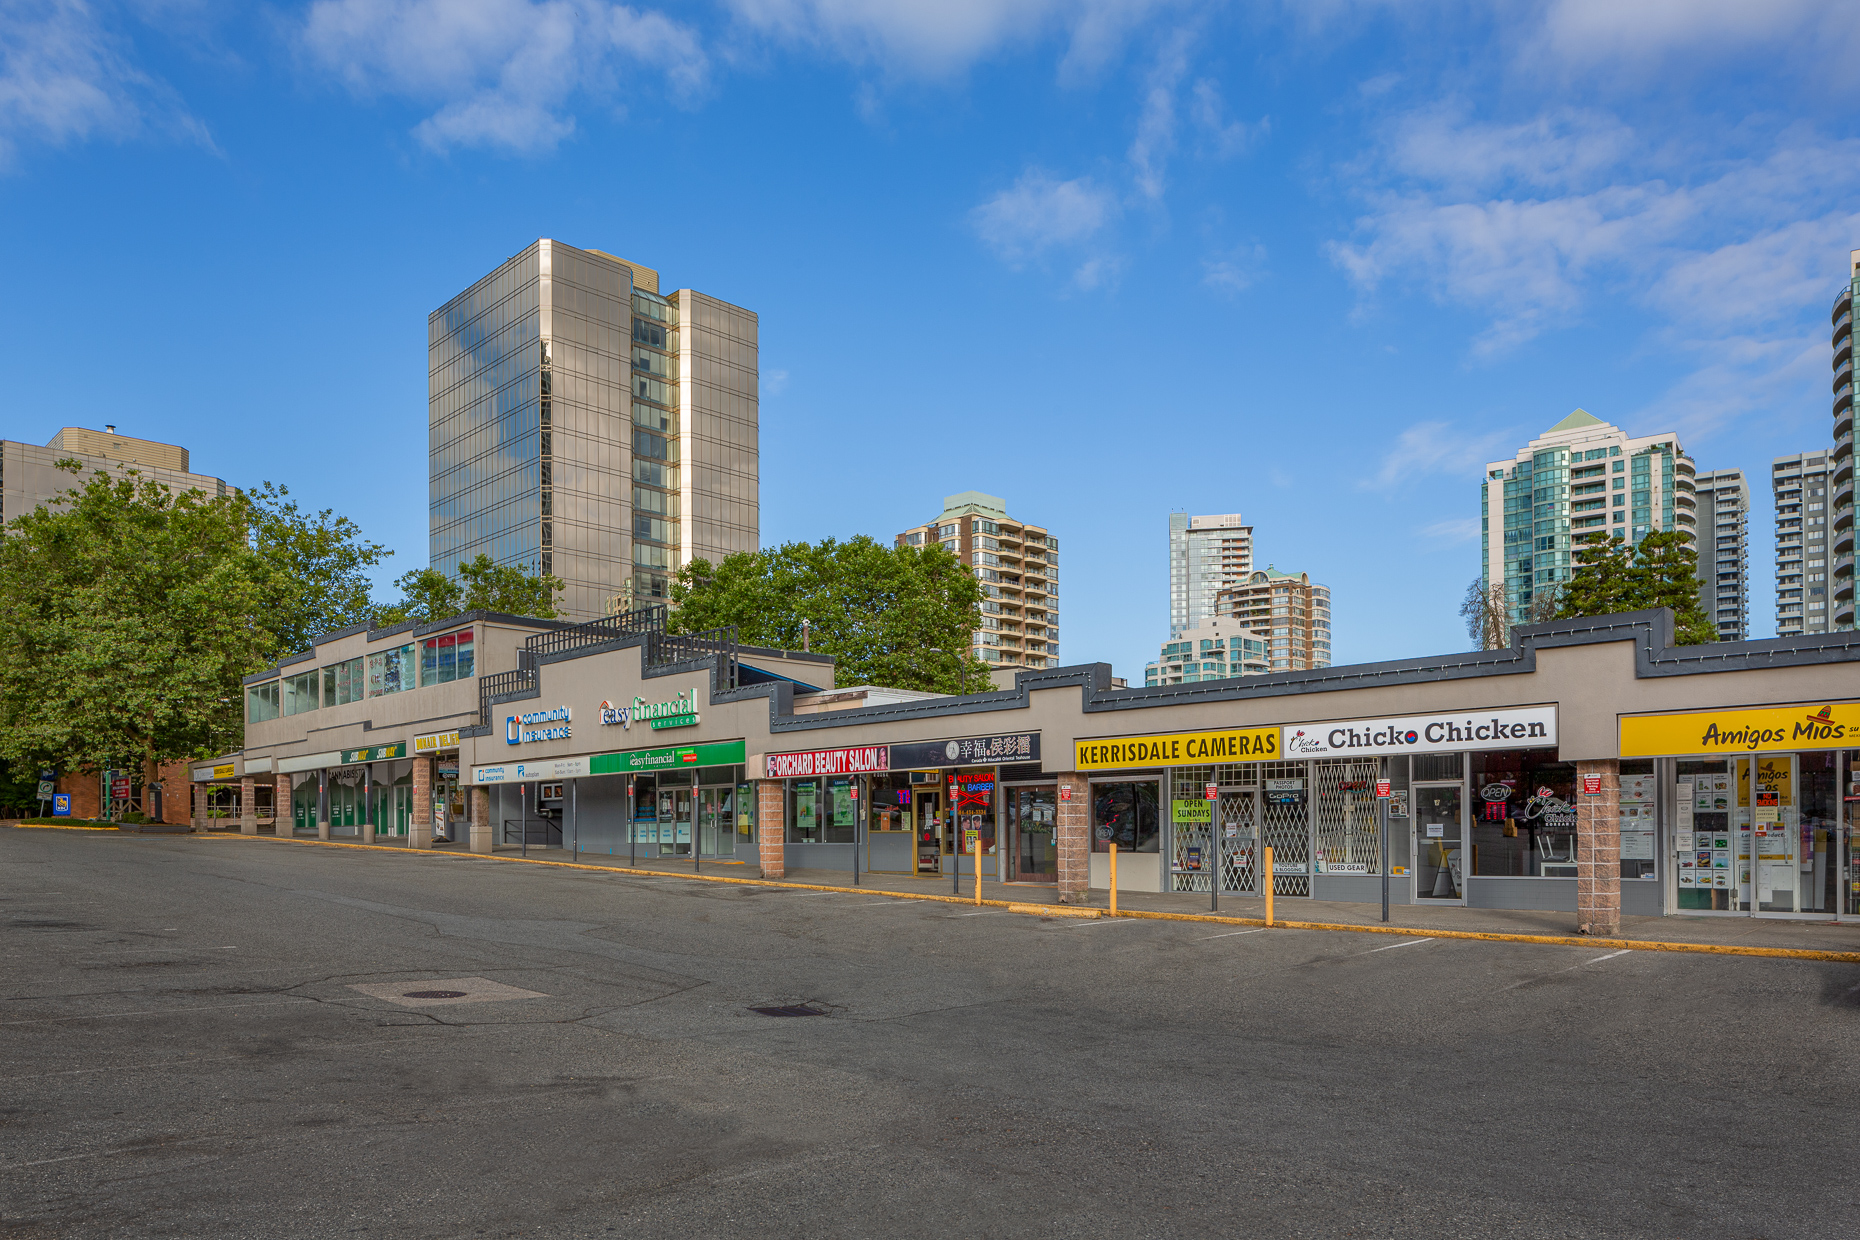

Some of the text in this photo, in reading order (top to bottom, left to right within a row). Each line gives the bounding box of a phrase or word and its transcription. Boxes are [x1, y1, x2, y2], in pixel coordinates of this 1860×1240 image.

[522, 705, 571, 724] community
[652, 716, 696, 728] services
[522, 726, 571, 743] insurance
[1327, 719, 1547, 749] Chicko Chicken
[1701, 722, 1786, 750] Amigos
[416, 736, 438, 750] DONAIR
[1080, 733, 1276, 765] KERRISDALE CAMERAS
[349, 750, 369, 762] SUBWAY
[376, 746, 397, 759] SUBWAY
[776, 748, 878, 776] ORCHARD BEAUTY SALON
[948, 773, 994, 783] BAUTY SALON
[967, 783, 994, 792] BARBER
[1482, 787, 1509, 797] OPEN
[1183, 800, 1203, 808] OPEN
[1177, 809, 1210, 818] SUNDAYS
